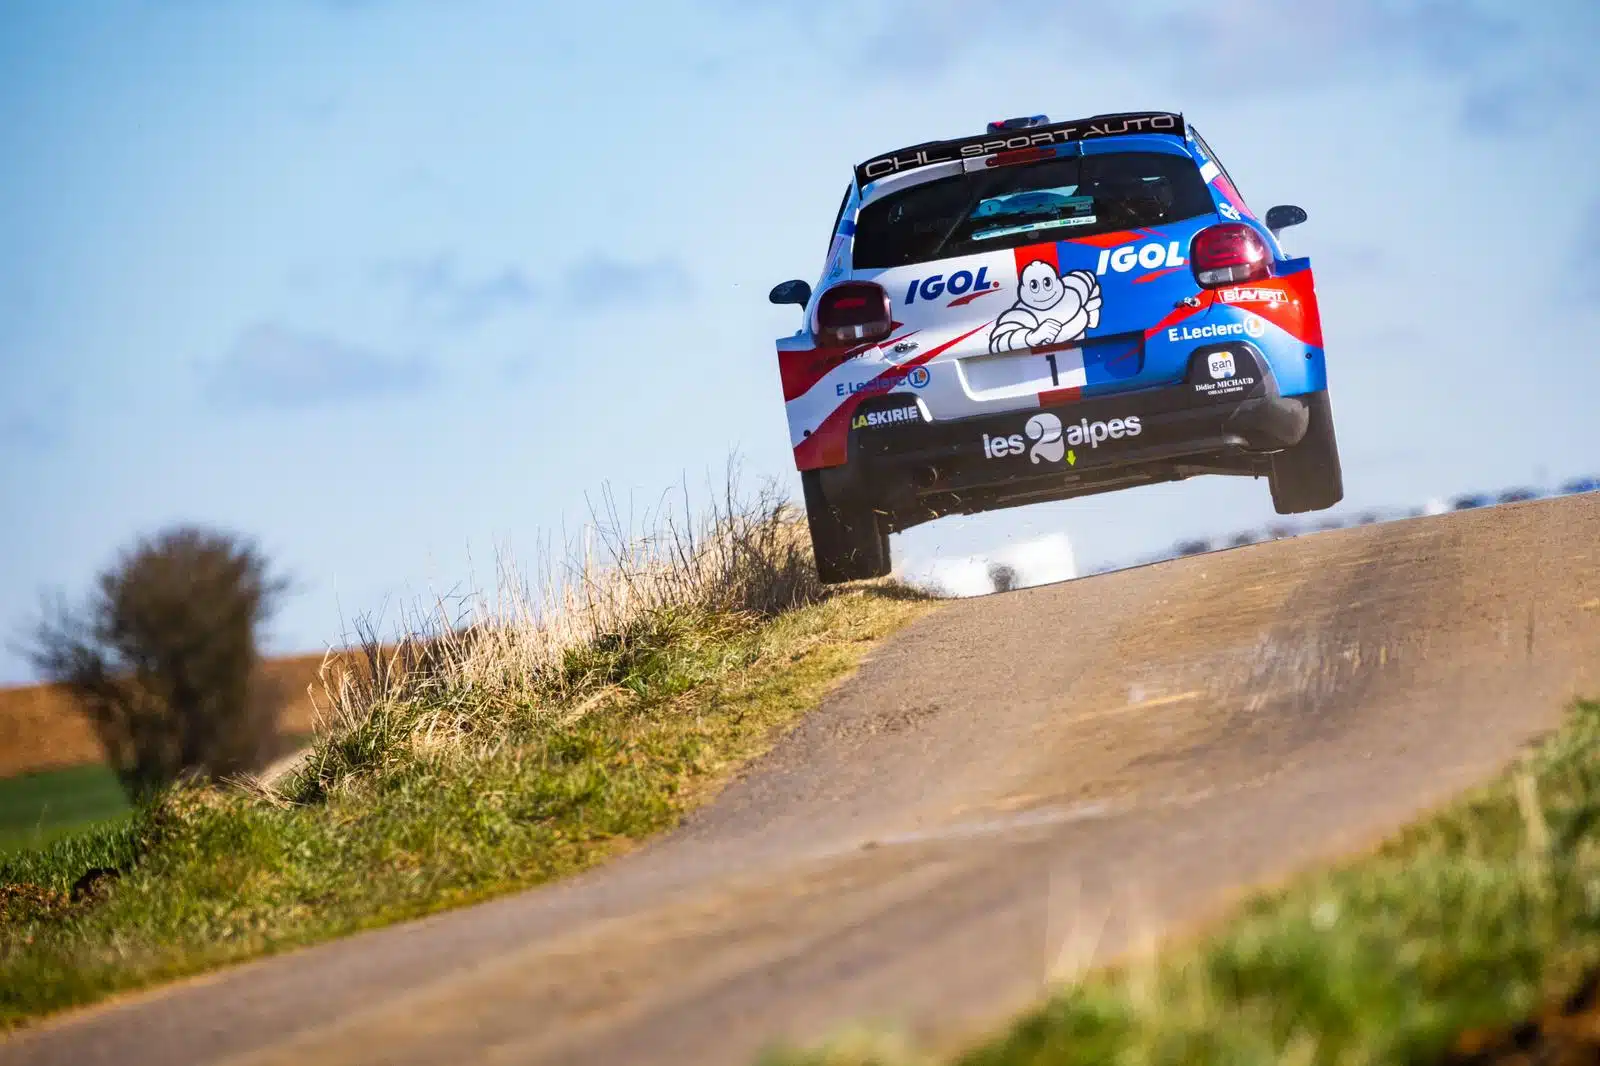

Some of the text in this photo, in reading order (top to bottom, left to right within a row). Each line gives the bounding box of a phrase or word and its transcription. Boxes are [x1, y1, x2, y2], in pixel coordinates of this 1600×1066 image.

[865, 114, 1175, 178] CHL SPORT AUTO
[1168, 323, 1243, 342] E.Leclerc
[1045, 354, 1059, 387] 1
[1211, 359, 1232, 372] gan
[1195, 383, 1216, 392] Didier
[1216, 377, 1254, 389] MICHAUD
[852, 405, 919, 430] LASKIRIE
[982, 412, 1142, 465] les 2 alpes
